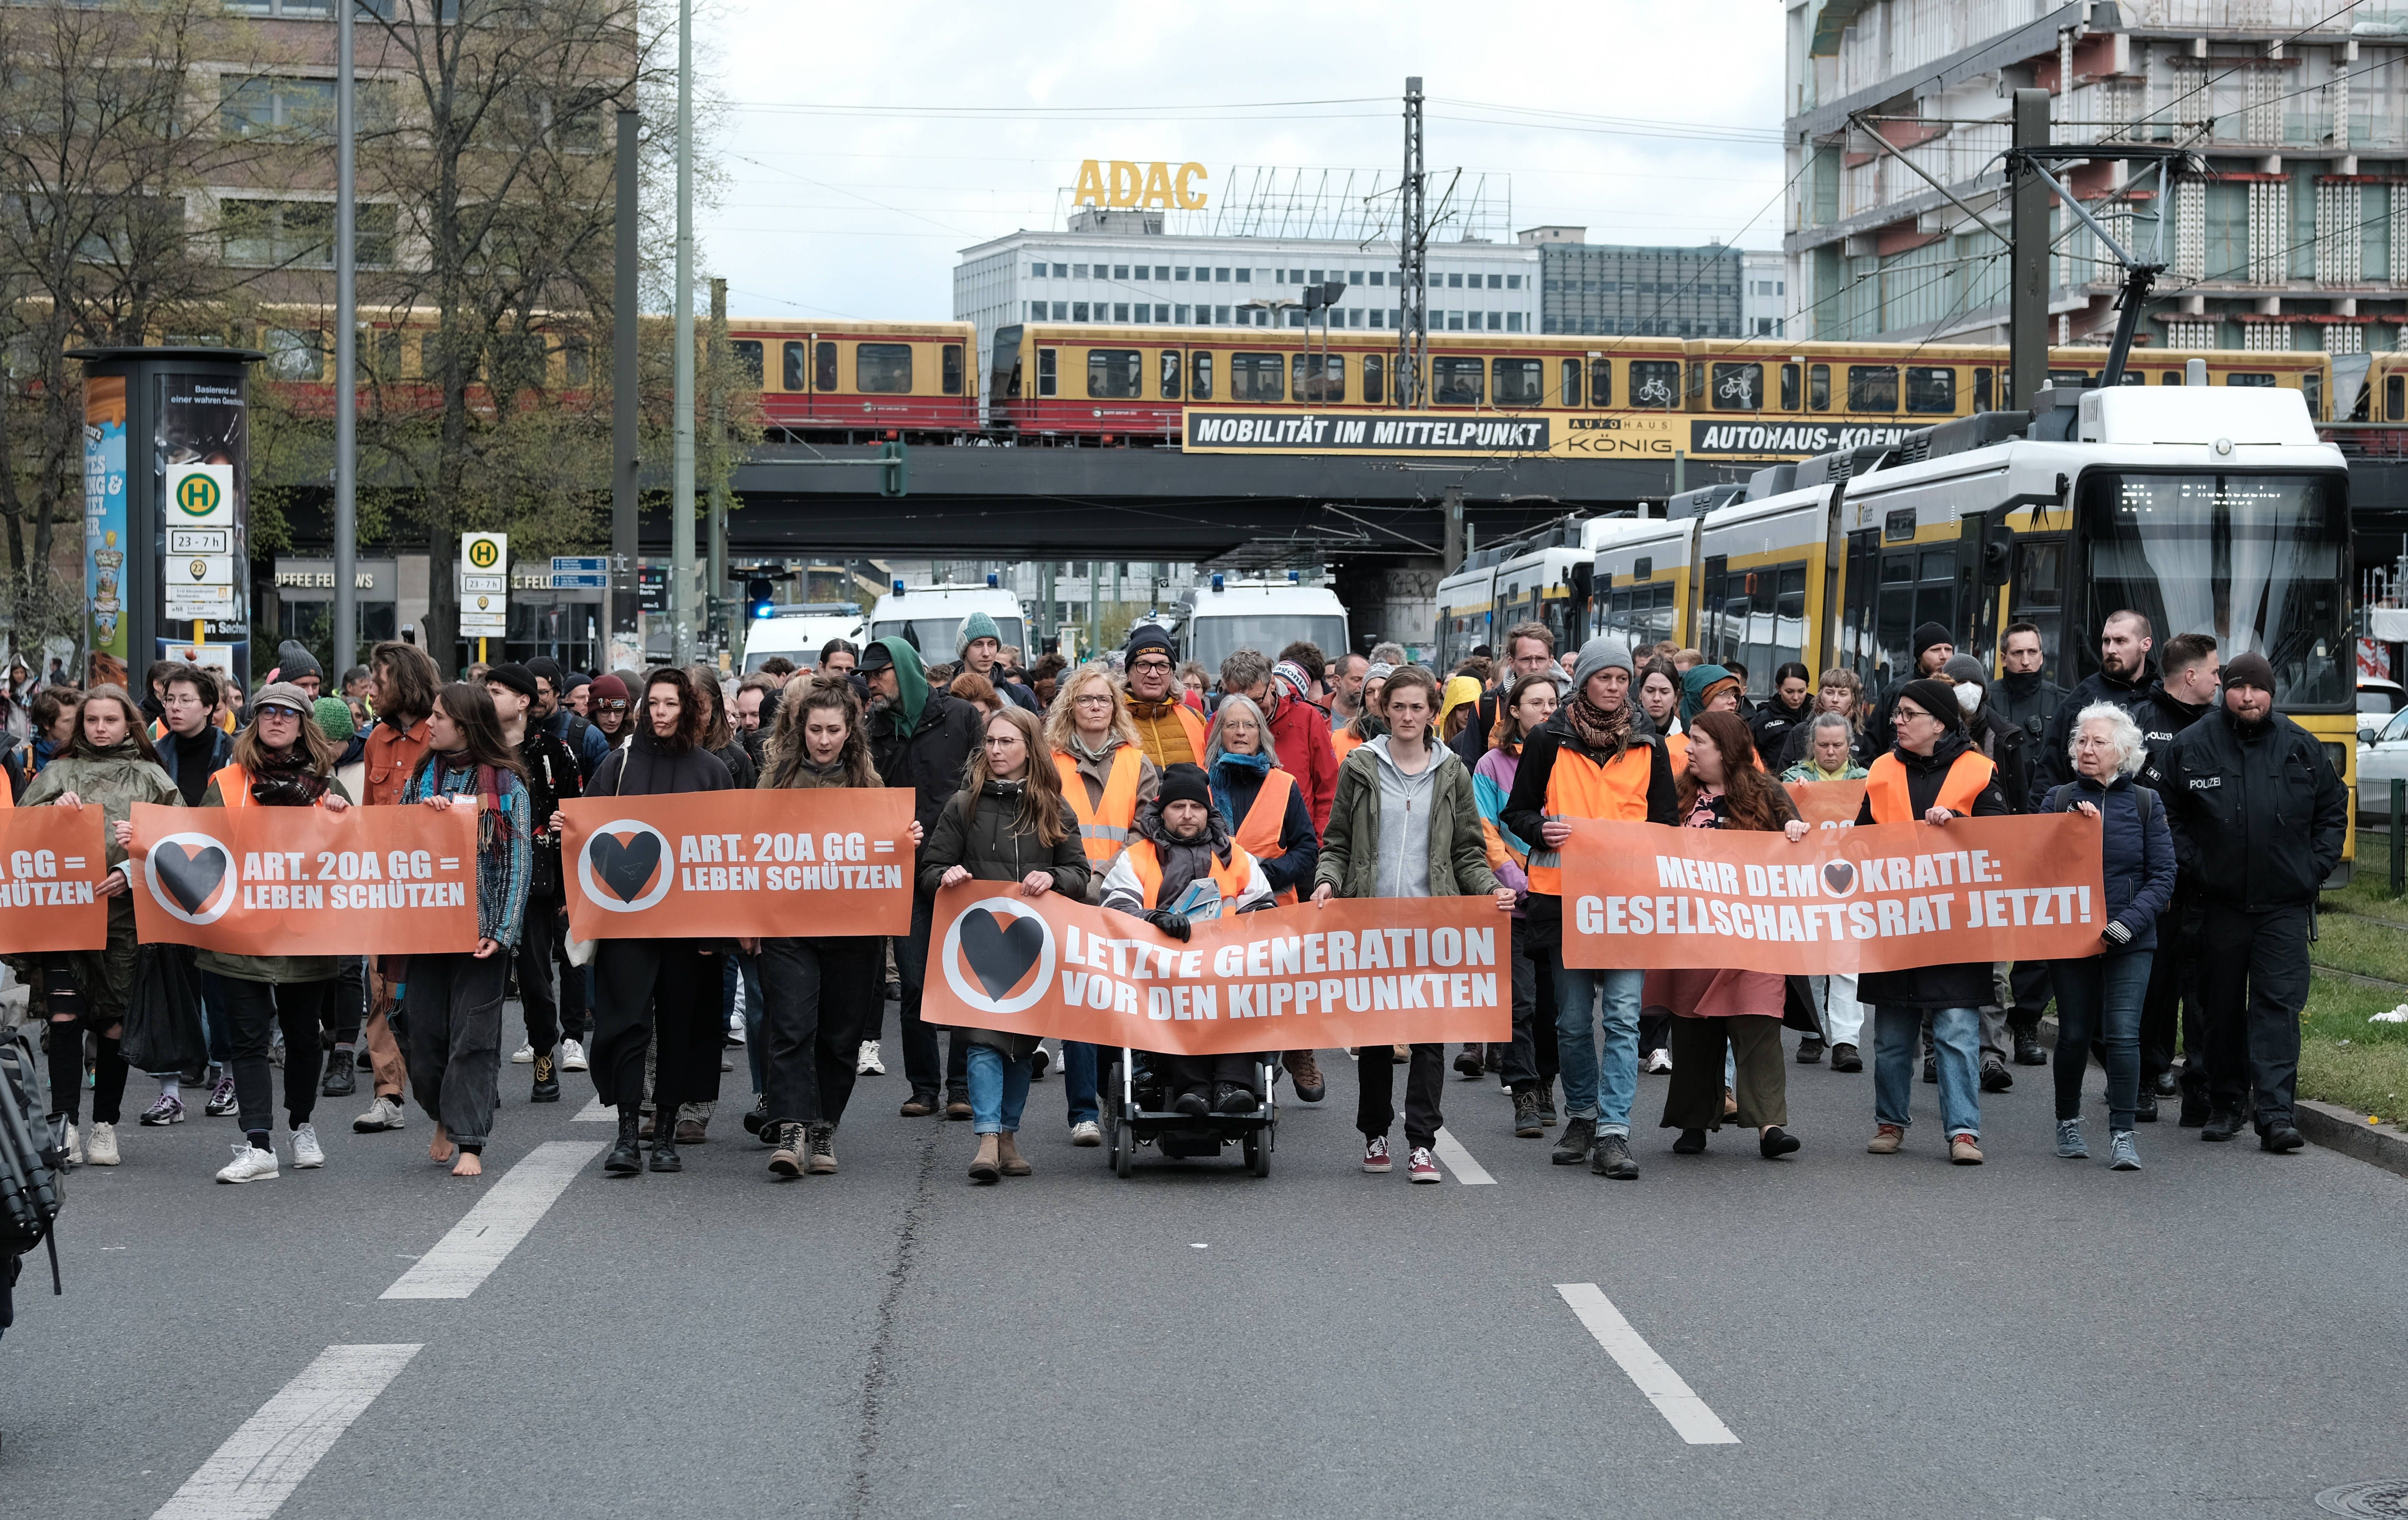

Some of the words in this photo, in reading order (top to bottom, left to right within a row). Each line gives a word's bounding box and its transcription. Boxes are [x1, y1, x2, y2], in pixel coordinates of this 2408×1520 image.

[1074, 160, 1208, 210] ADAC
[195, 385, 229, 394] Basierend
[1197, 415, 1328, 442] MOBILITÄT
[1334, 421, 1366, 443] IM
[1372, 422, 1541, 446] MITTELPUNKT
[1569, 434, 1672, 452] KÖNIG
[85, 455, 105, 475] TES
[85, 475, 105, 495] ING
[108, 475, 123, 495] &
[188, 484, 208, 506] H
[85, 496, 106, 515] IEL
[85, 517, 100, 536] HR
[179, 536, 191, 547] 23
[203, 536, 209, 547] 7
[213, 536, 219, 547] h
[477, 546, 491, 561] H
[2145, 731, 2173, 741] POLIZEI
[2190, 777, 2221, 789] POLIZEI
[679, 834, 746, 863] ART.
[754, 833, 816, 862] 20A
[823, 832, 866, 861] GG
[874, 841, 894, 853] =
[11, 849, 56, 879] GG
[64, 857, 85, 869] =
[242, 852, 310, 881] ART.
[317, 851, 381, 880] 20A
[388, 850, 432, 879] GG
[440, 857, 459, 870] =
[682, 866, 759, 891] LEBEN
[767, 862, 901, 891] SCHÜTZEN
[1656, 856, 1740, 895] MEHR
[0, 879, 94, 907] HÜTZEN
[244, 884, 323, 909] LEBEN
[330, 880, 465, 909] SCHÜTZEN
[1576, 893, 1954, 941] GESELLSCHAFTSRAT
[1967, 886, 2091, 928] JETZT!
[1065, 925, 1203, 979] LETZTE
[1213, 927, 1495, 978] GENERATION
[1062, 970, 1138, 1015] VOR
[1148, 985, 1217, 1020] DEN
[1228, 973, 1497, 1019] KIPPPUNKTEN
